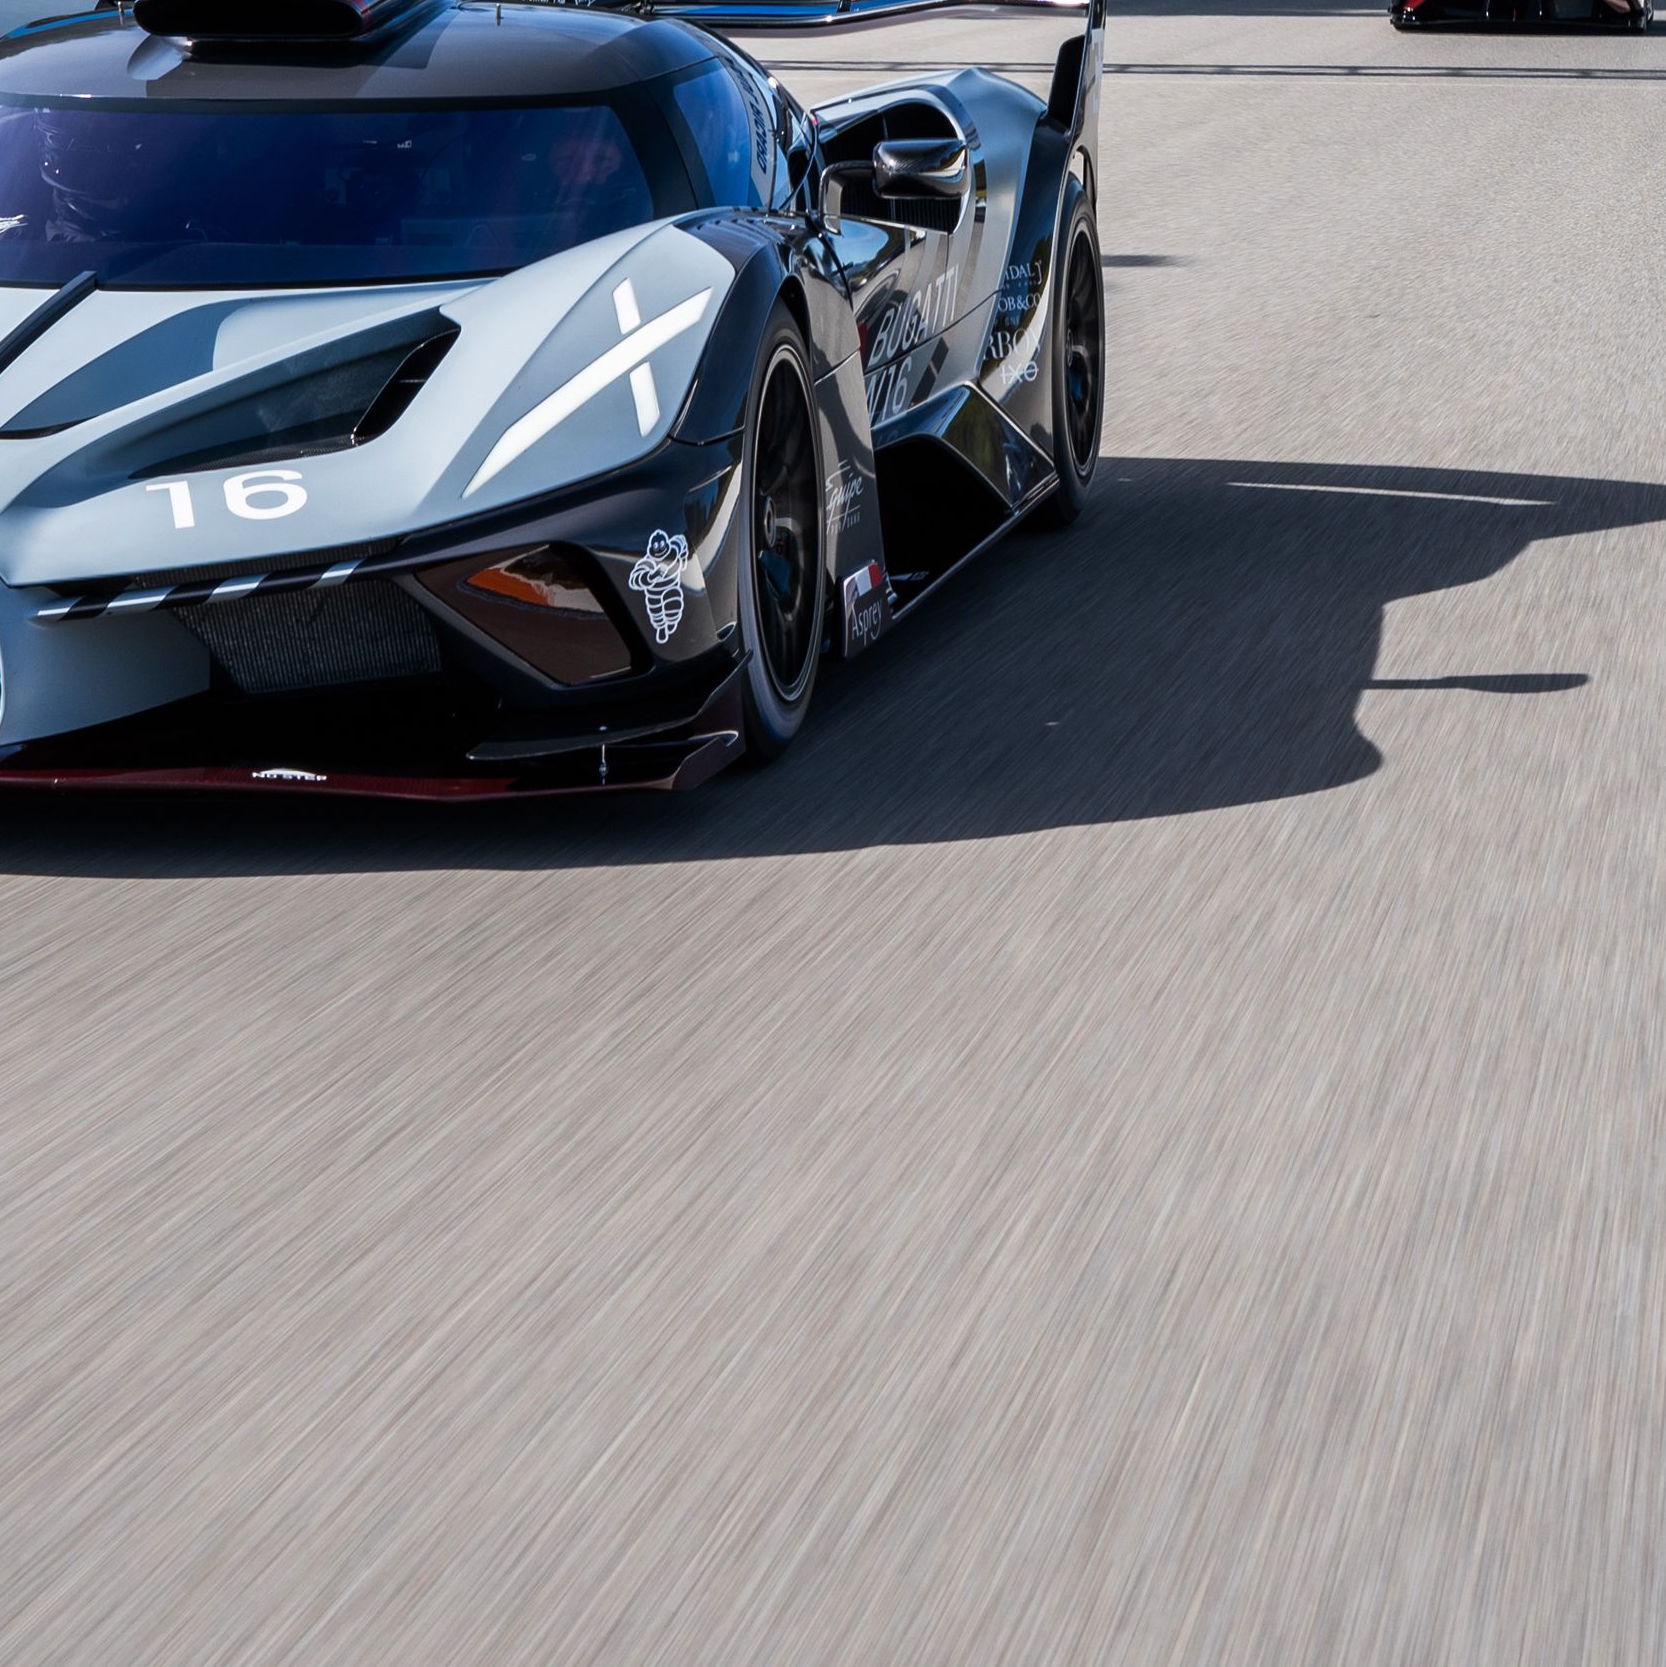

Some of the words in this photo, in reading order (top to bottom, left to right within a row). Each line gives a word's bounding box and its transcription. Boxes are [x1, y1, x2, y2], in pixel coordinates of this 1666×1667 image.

[868, 263, 959, 368] BUGATTI
[997, 292, 1041, 313] OB&CO
[983, 328, 1041, 361] RBON
[145, 469, 308, 530] 16
[852, 600, 882, 647] Asprey
